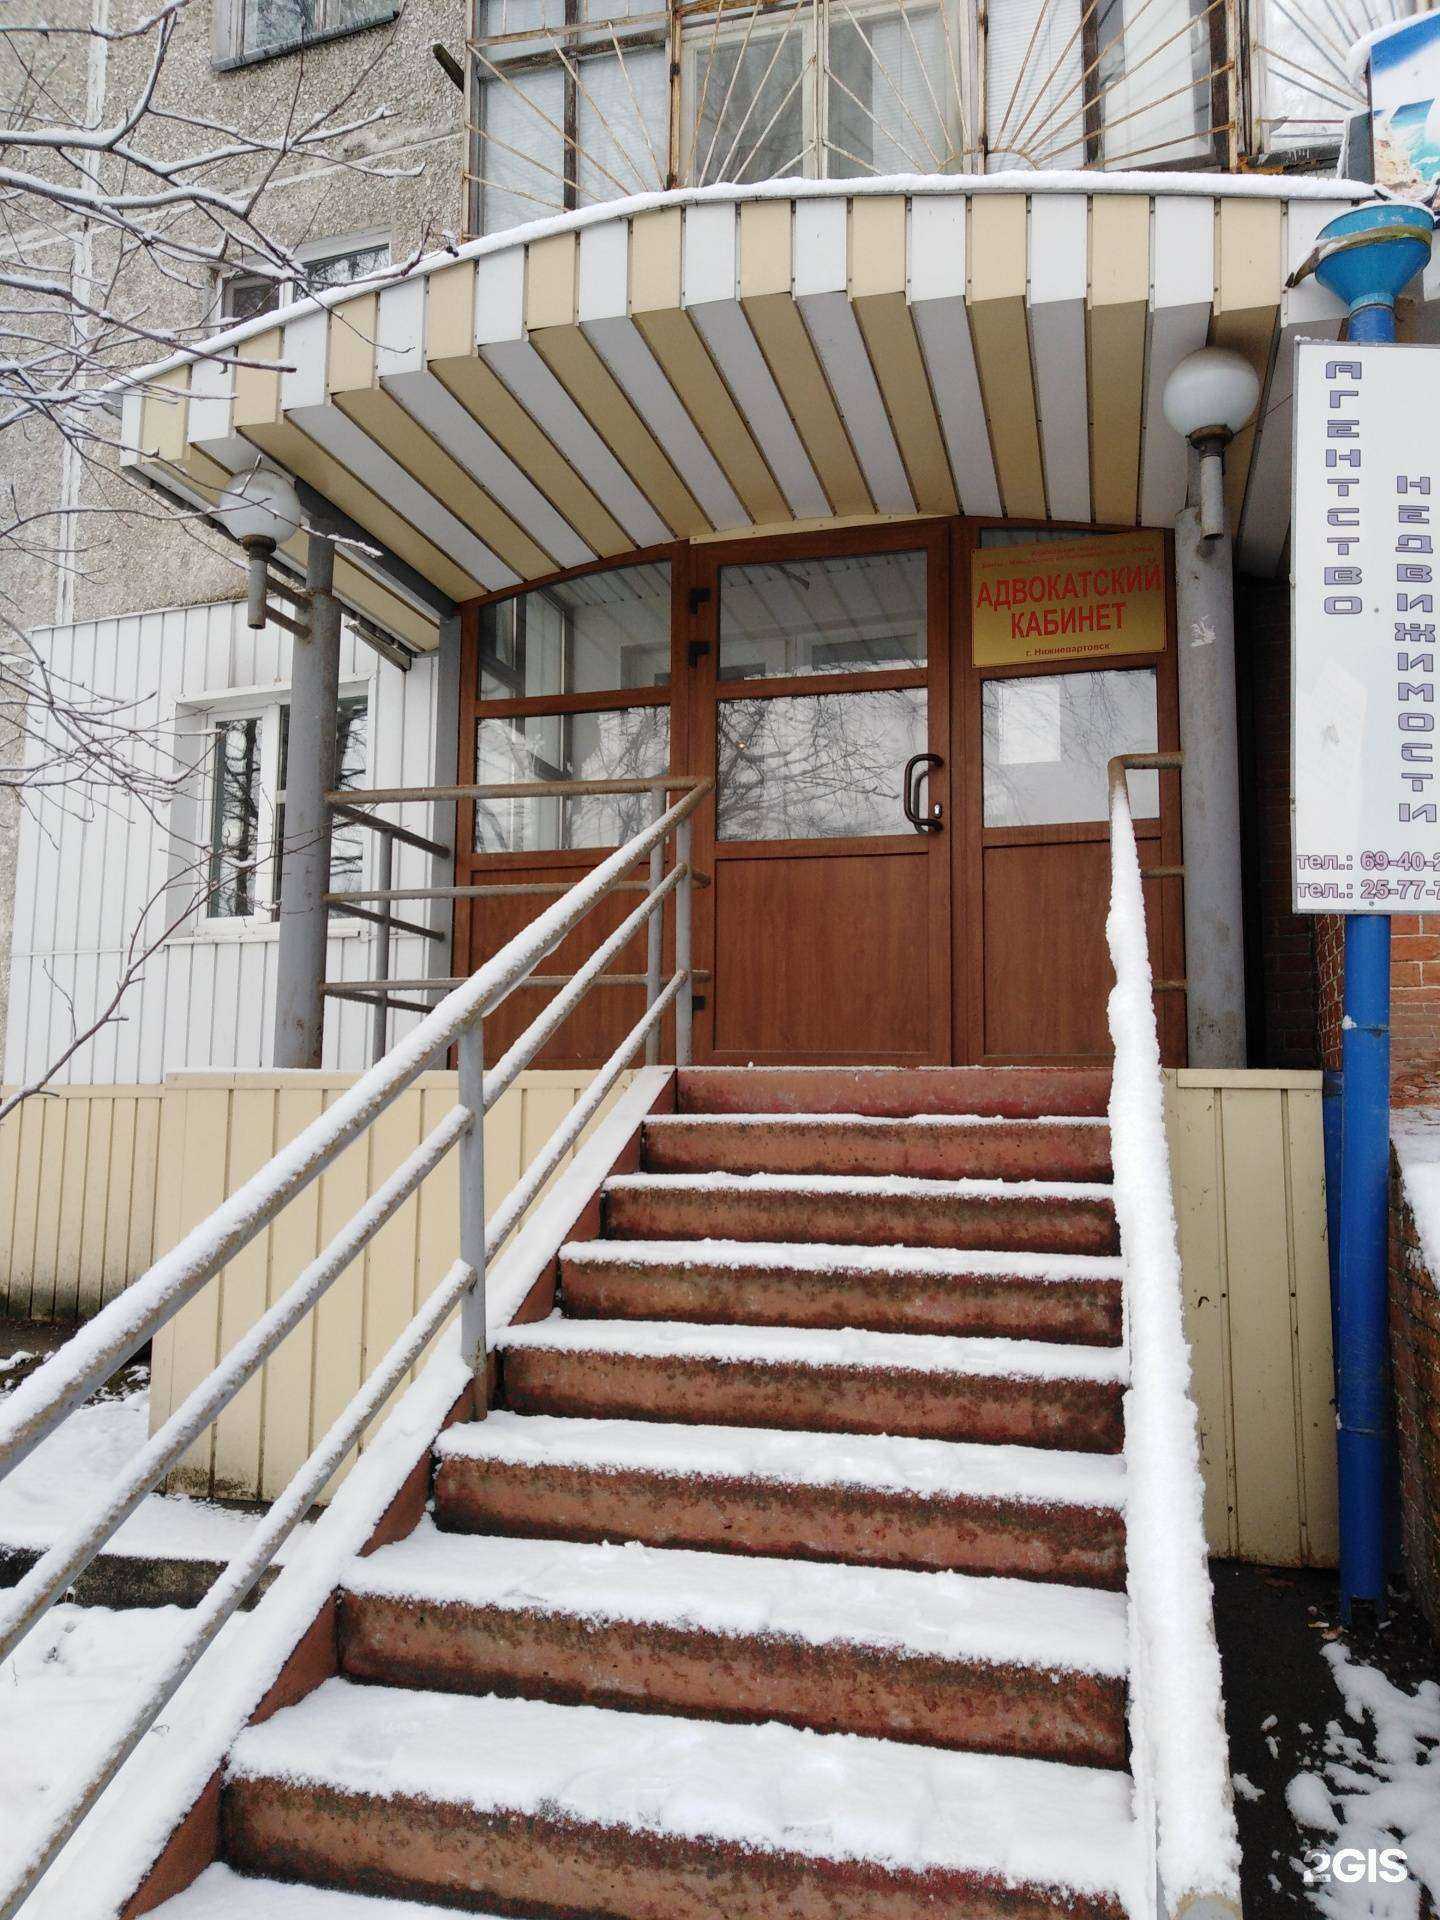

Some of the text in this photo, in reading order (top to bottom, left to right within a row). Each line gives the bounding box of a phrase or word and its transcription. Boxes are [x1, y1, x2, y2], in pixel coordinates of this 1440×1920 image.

[1323, 361, 1363, 615] АГЕНТСТВО
[977, 558, 1163, 612] АДВОКАТСКИЙ
[1011, 602, 1127, 640] КАБИНЕТ
[1394, 475, 1437, 823] НЕДВИЖИМОСТИ
[1297, 855, 1353, 870] тел.:
[1297, 883, 1353, 899] тел.:
